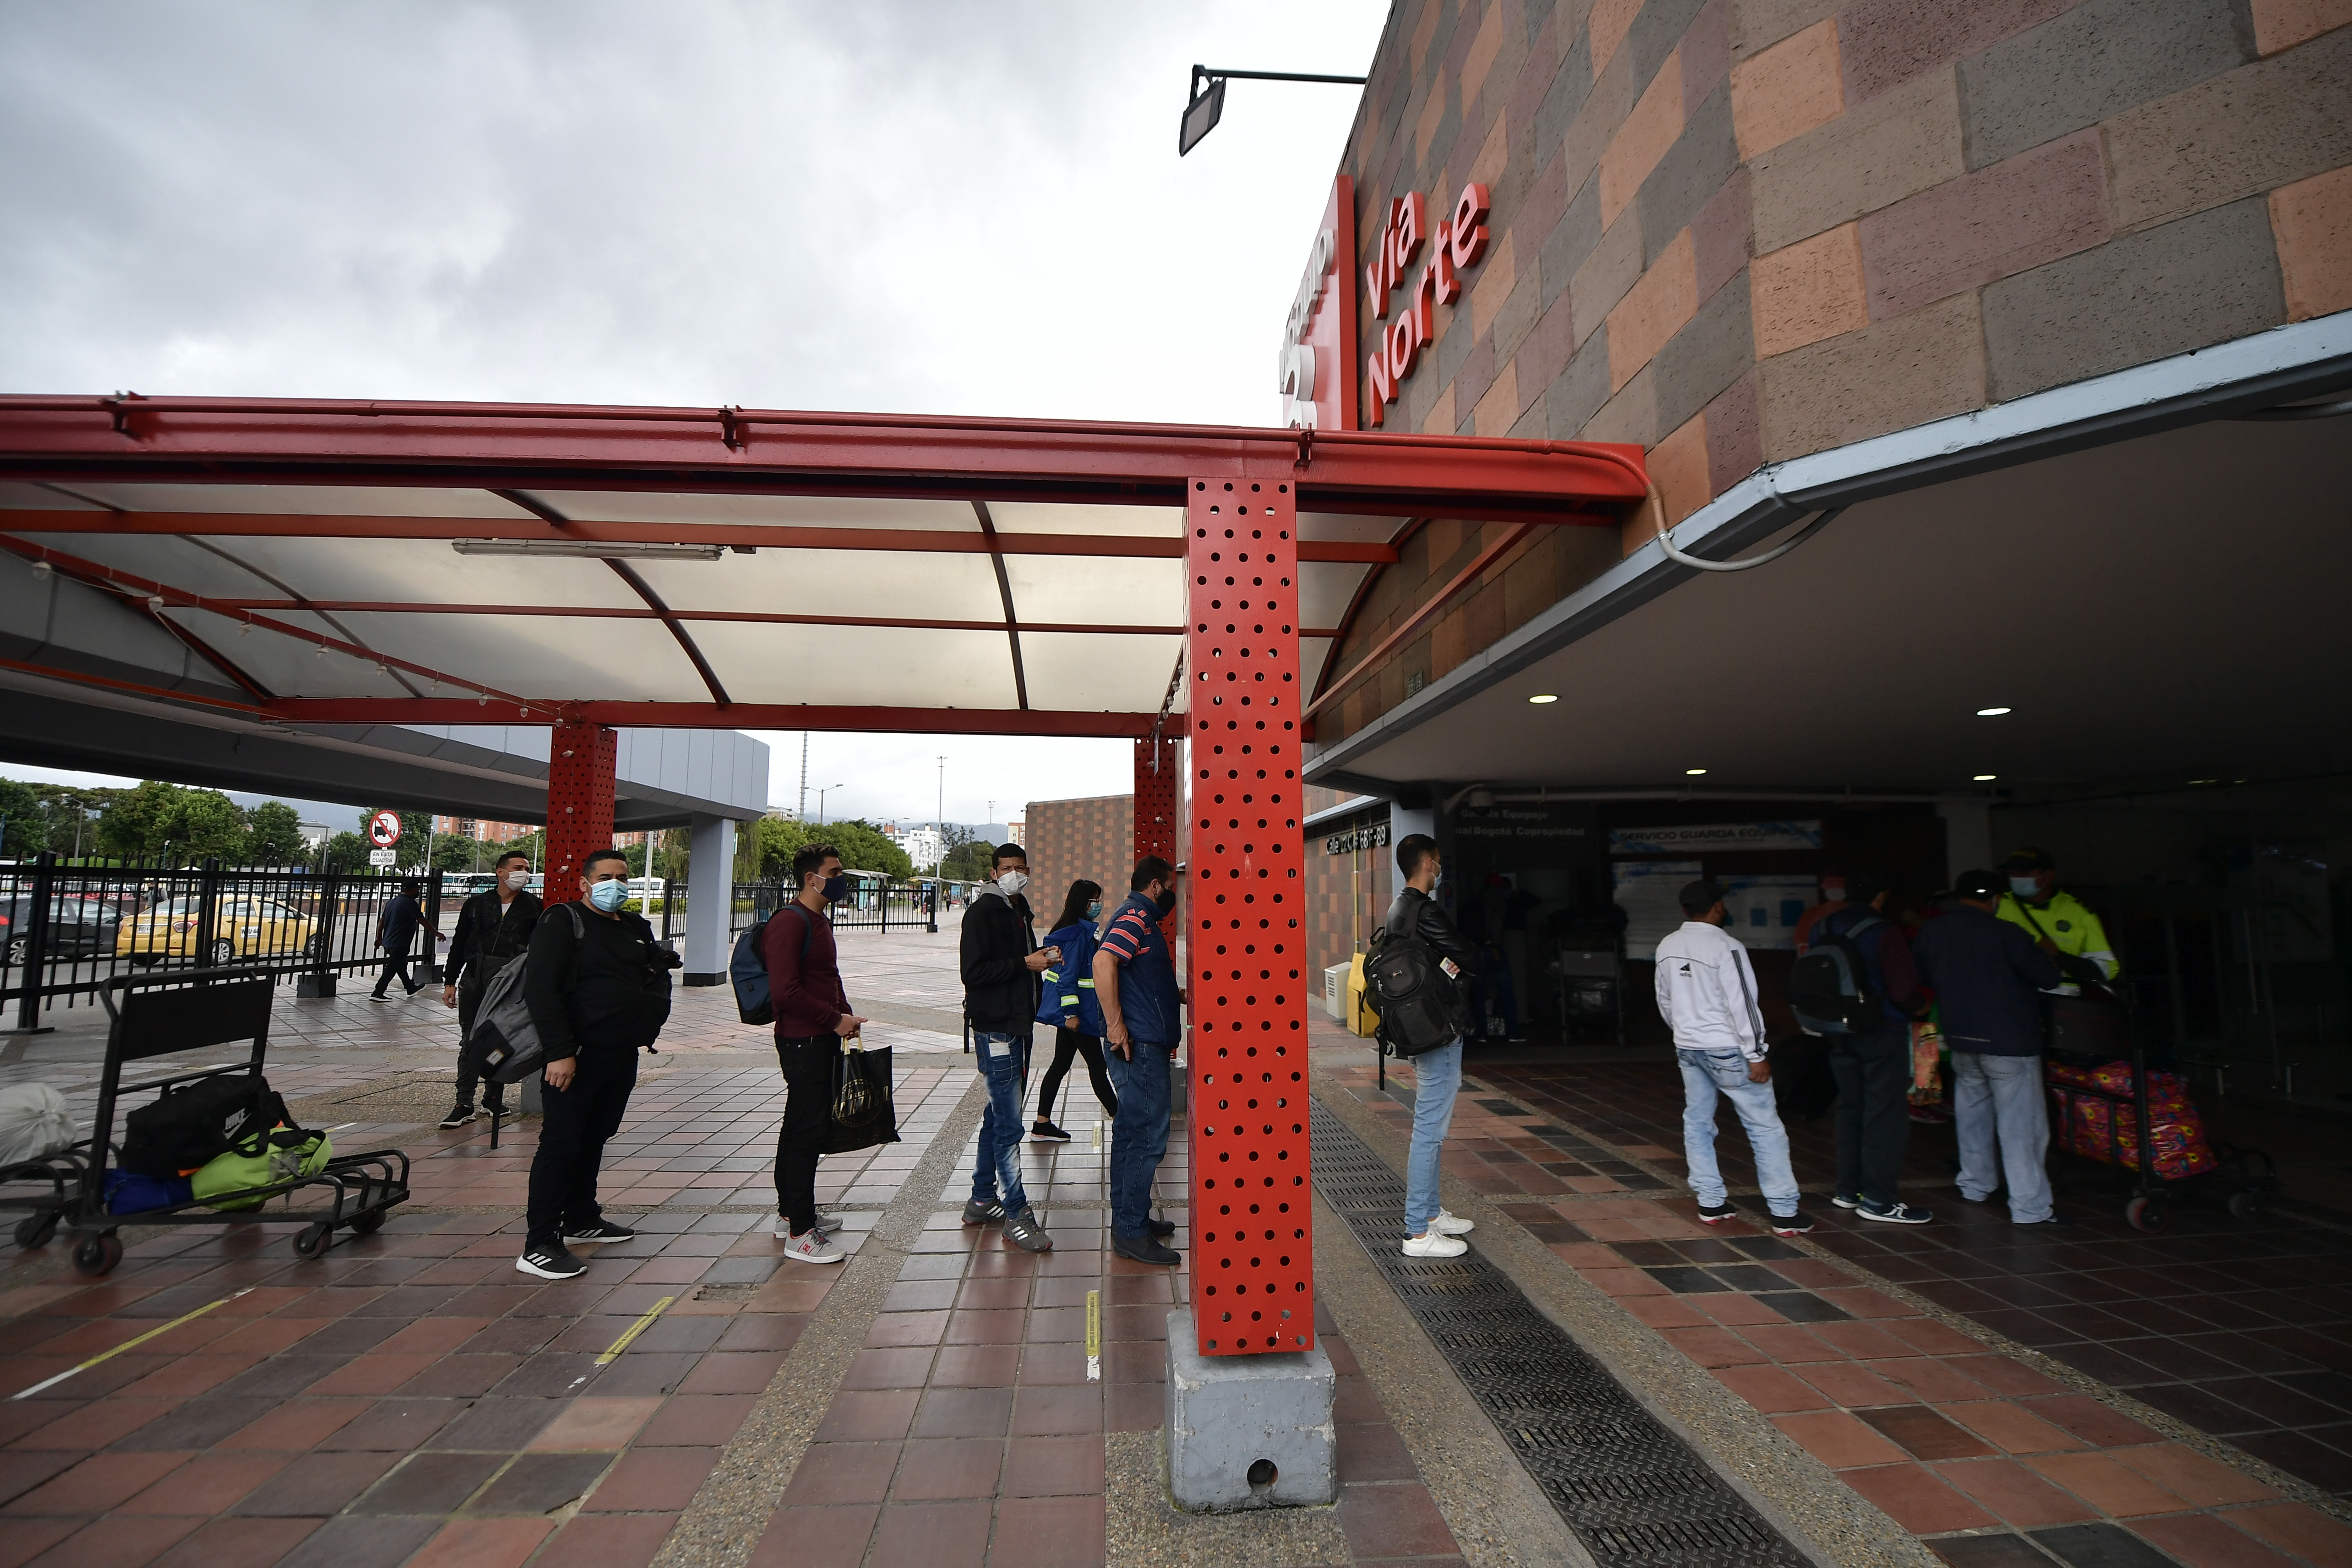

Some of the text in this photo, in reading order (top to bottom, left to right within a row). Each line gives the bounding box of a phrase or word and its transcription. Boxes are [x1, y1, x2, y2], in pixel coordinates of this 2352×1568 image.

[1366, 191, 1426, 320] Vía
[1369, 182, 1490, 427] Norte
[1502, 809, 1549, 820] Equipaje
[1473, 826, 1511, 837] Bogotá
[1516, 826, 1585, 837] Copropiedad
[1620, 831, 1676, 841] SERVICIO
[1680, 829, 1736, 840] GUARDA
[1326, 837, 1339, 855] Calle
[225, 1108, 246, 1130] NIKE
